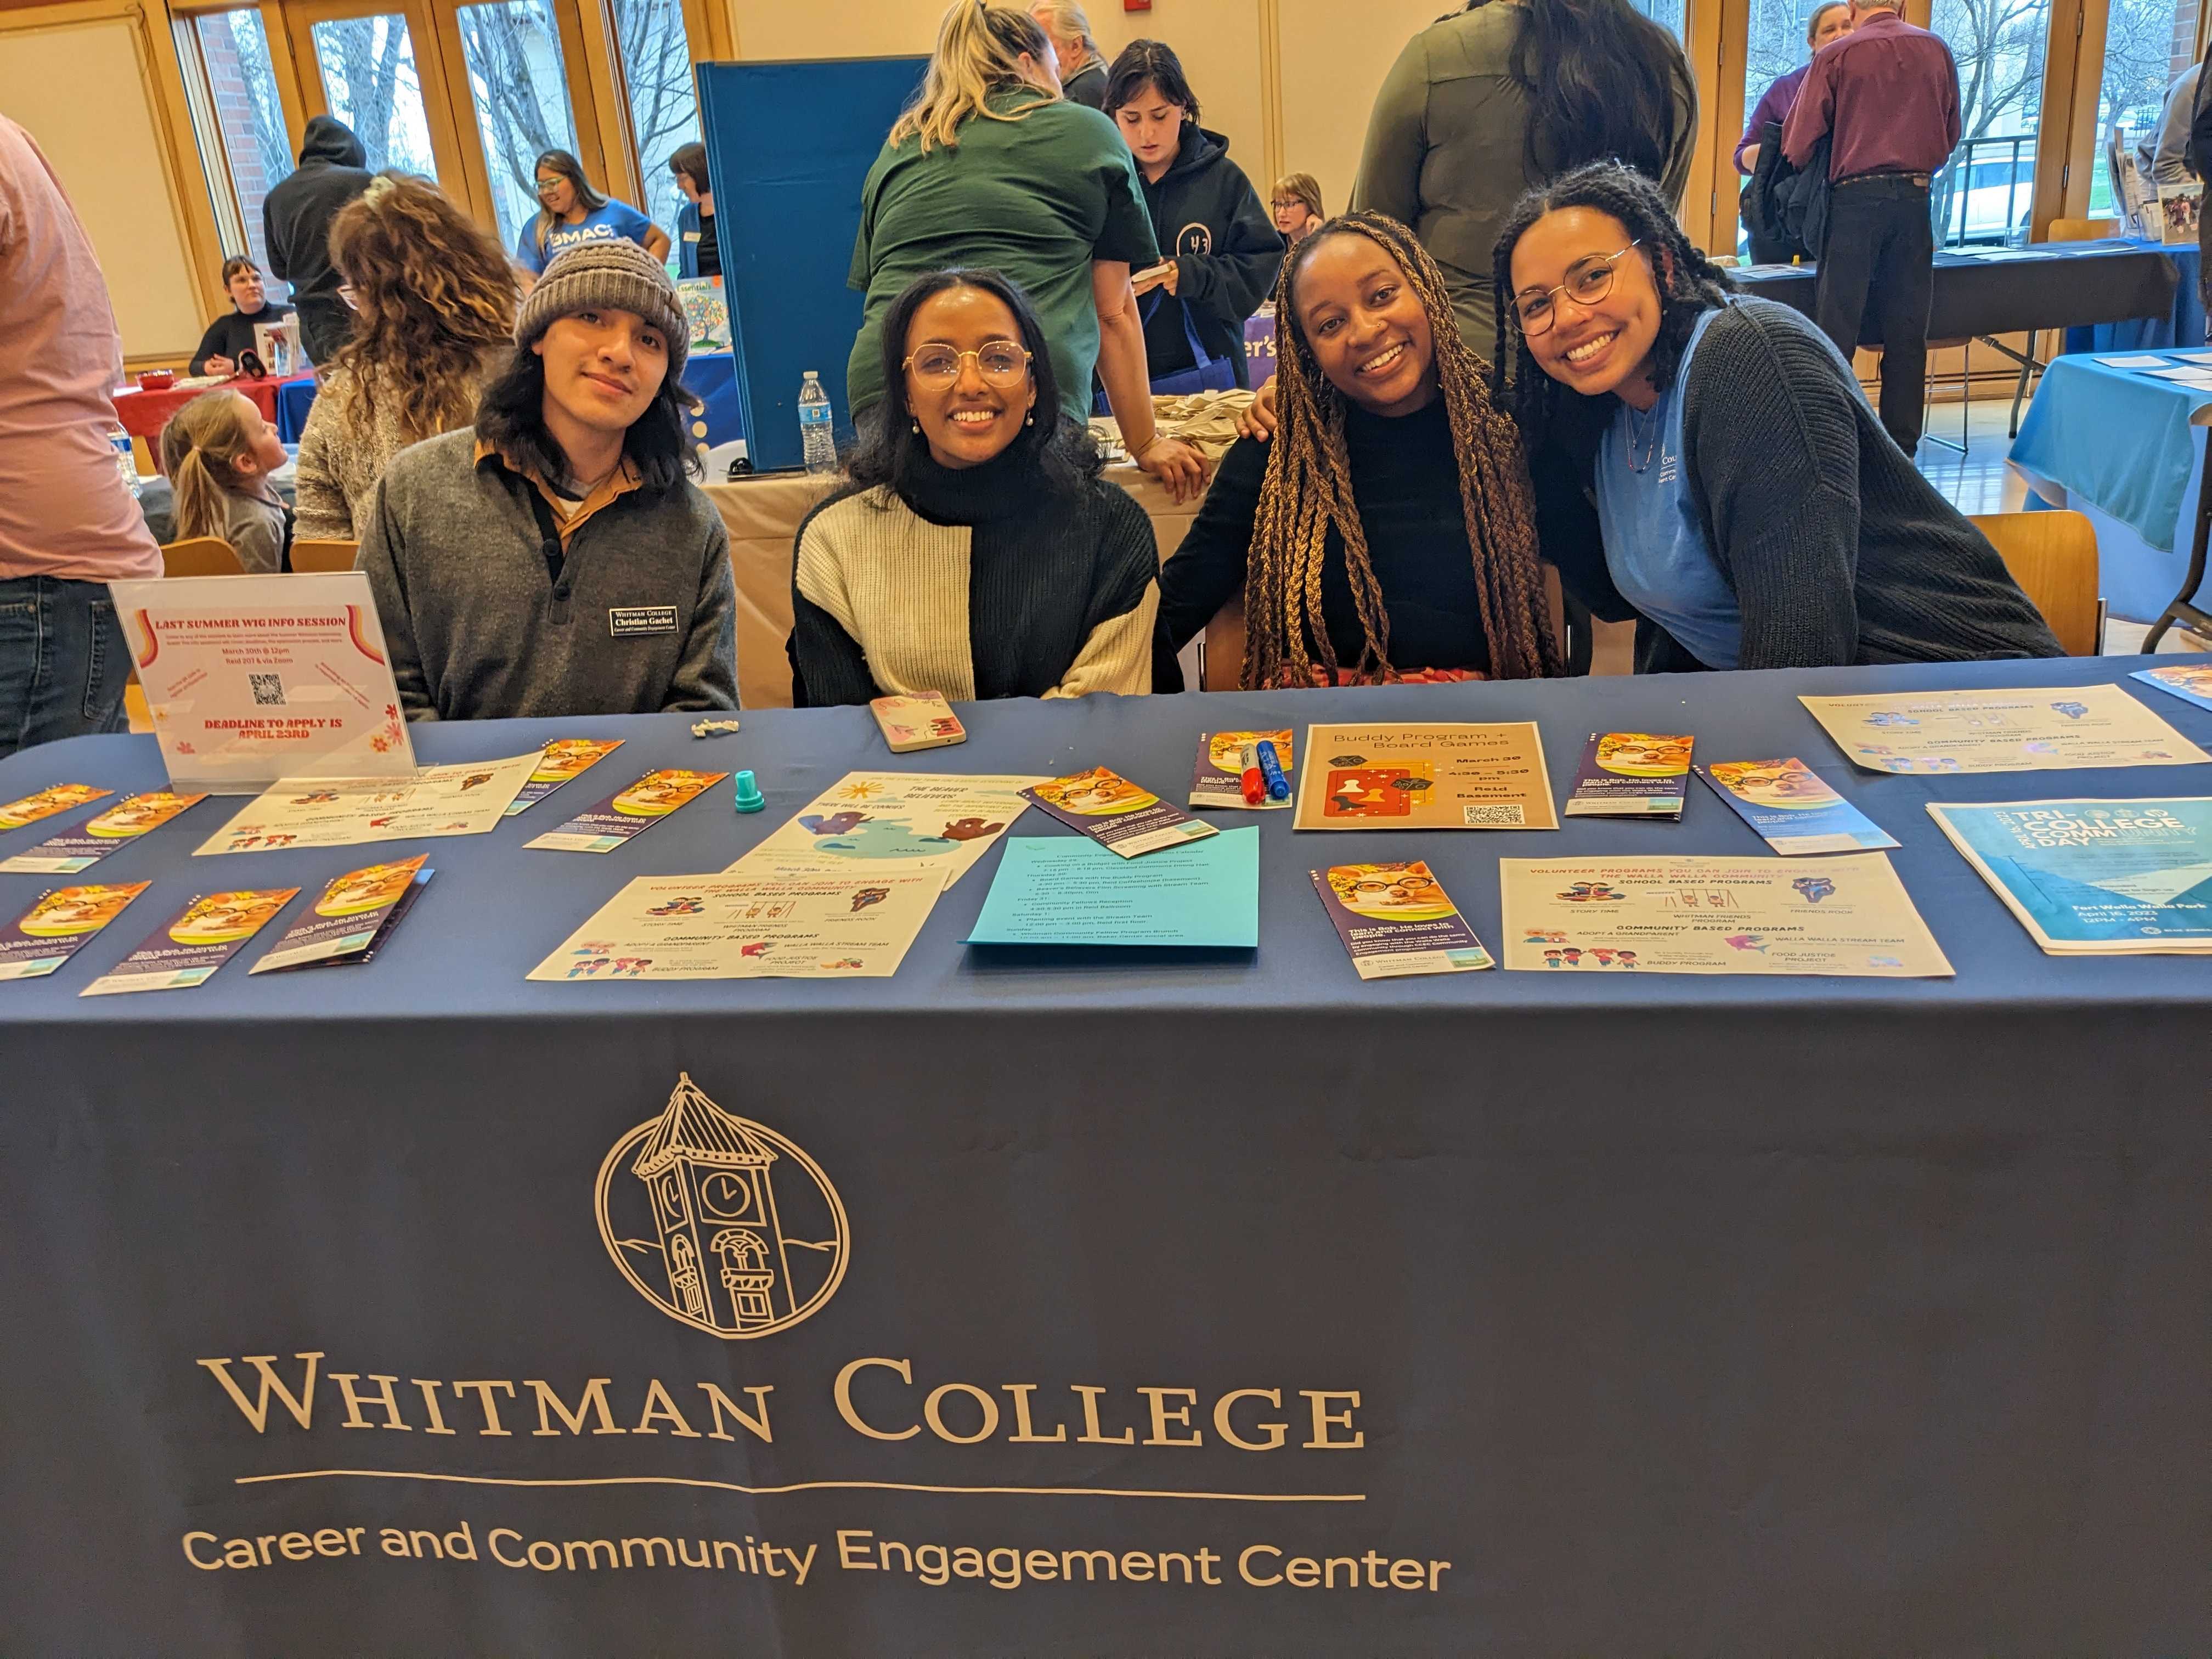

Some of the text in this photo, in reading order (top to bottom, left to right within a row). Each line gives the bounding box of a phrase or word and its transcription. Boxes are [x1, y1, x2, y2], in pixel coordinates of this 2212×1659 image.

[155, 618, 346, 629] LAST SUMMER WIG INFO SESSION
[205, 719, 342, 729] DEADLINE TO APPLY IS
[239, 730, 309, 738] APRIL 23RD
[2011, 810, 2076, 821] TRI-
[2023, 817, 2185, 831] COLLEGE
[2037, 838, 2090, 847] DAY
[196, 1352, 1363, 1450] WHITMAN COLLEGE
[183, 1521, 1451, 1592] Career and Community Engagement Center
